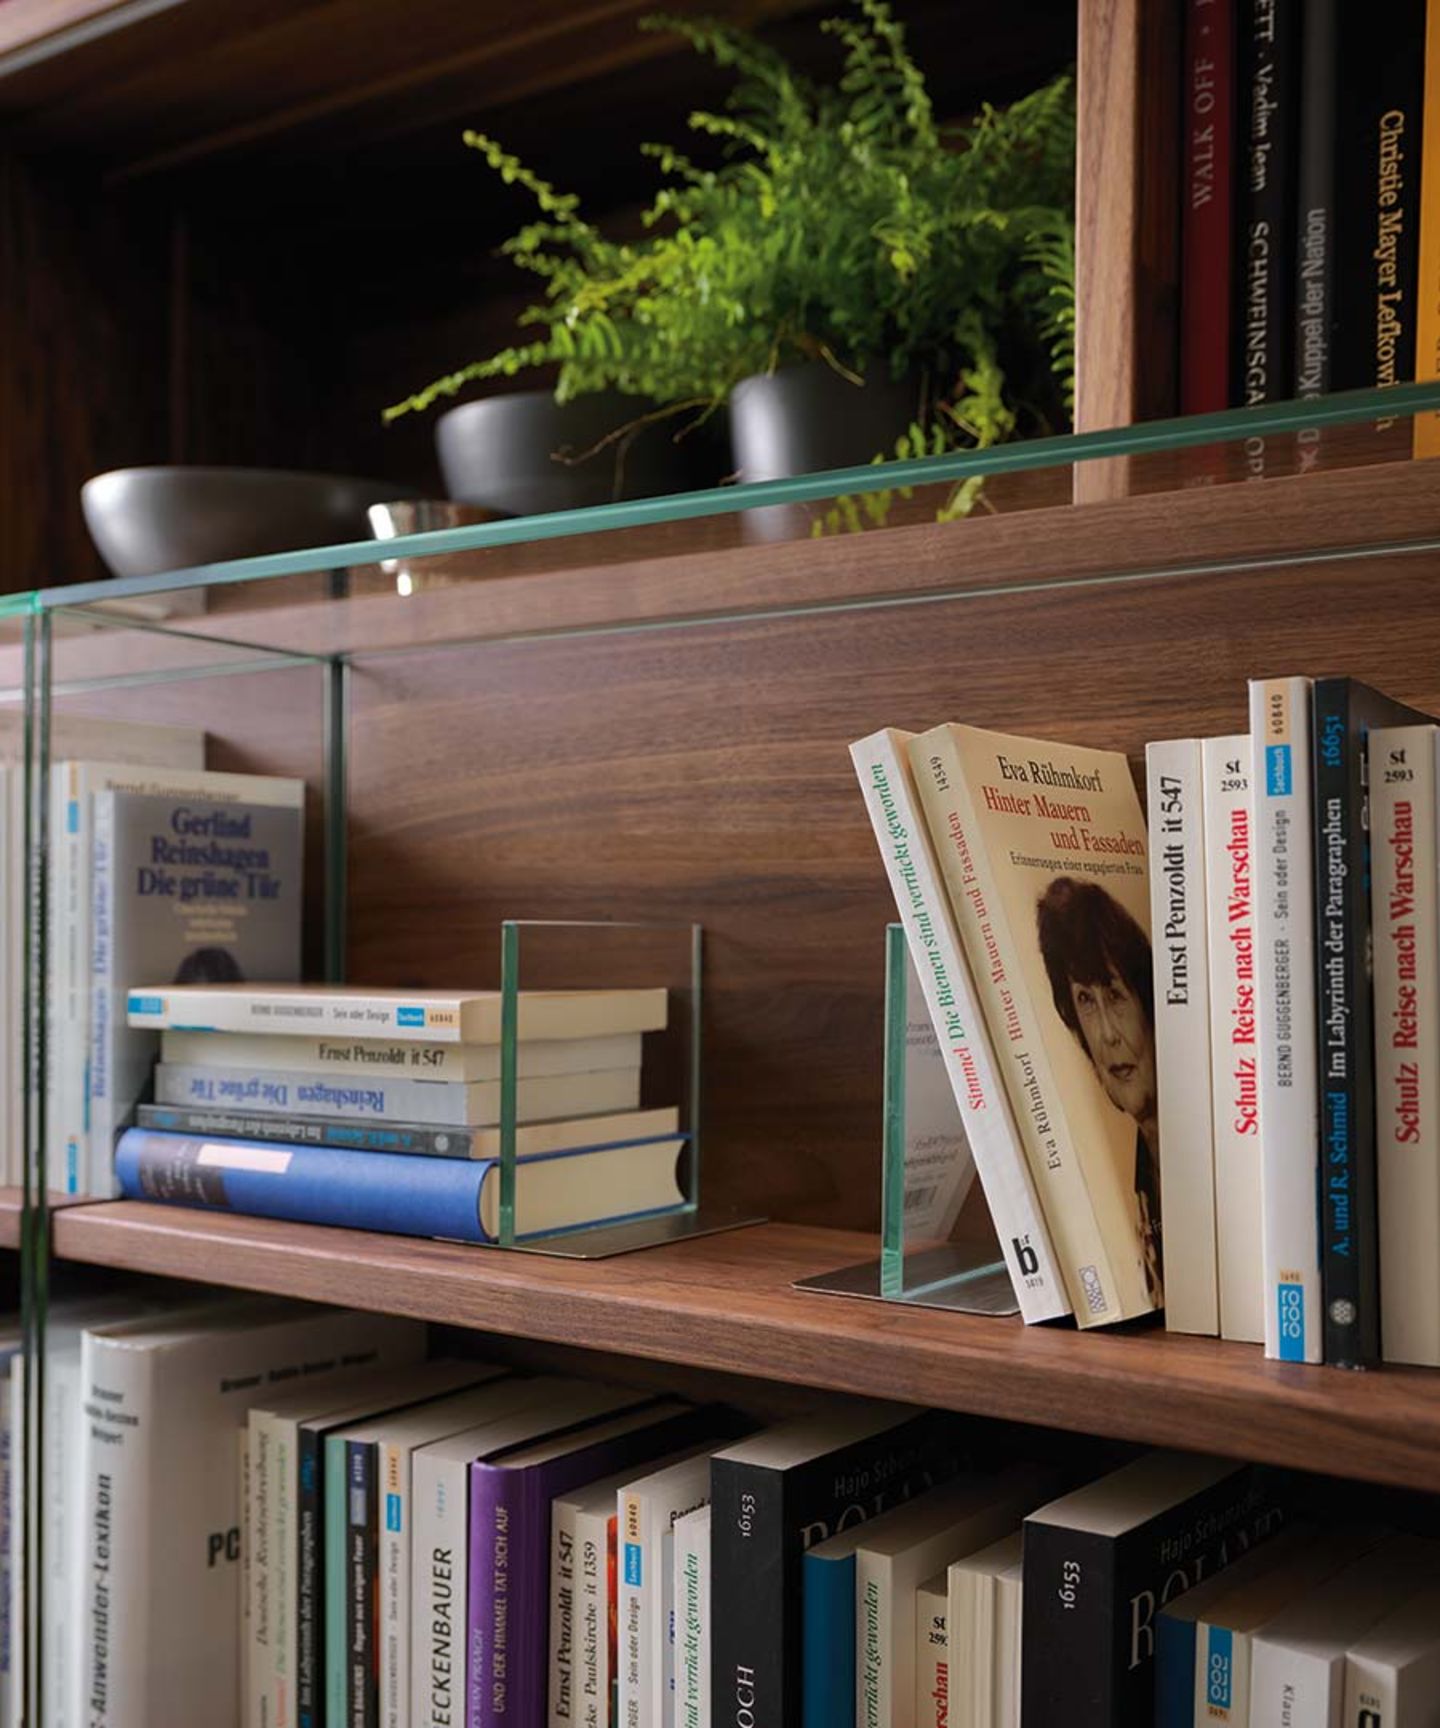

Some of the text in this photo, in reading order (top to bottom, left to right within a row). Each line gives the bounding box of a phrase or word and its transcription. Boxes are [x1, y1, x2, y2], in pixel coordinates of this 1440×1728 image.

[1193, 59, 1215, 209] WALK OFF
[1378, 110, 1405, 206] Christie
[1302, 209, 1326, 278] Nation
[1374, 207, 1403, 287] Mayer
[1301, 281, 1324, 315] der
[1299, 317, 1328, 394] Kuppel
[1271, 694, 1283, 735] 60840
[1322, 715, 1345, 768] 16651
[1389, 749, 1406, 765] st
[929, 756, 950, 792] 14549
[997, 755, 1104, 793] Eva Rühmkorf
[1221, 778, 1249, 793] 2593
[1226, 758, 1241, 774] st
[1384, 769, 1415, 784] 2593
[982, 785, 1092, 823] Hinter Mauern
[152, 836, 271, 872] Reinshagen
[1050, 825, 1145, 857] und Fassaden
[137, 867, 175, 896] Die
[1160, 776, 1189, 1006] Ernst Penzoldt it 547
[871, 763, 987, 1111] Simmel Die Bienen sind verrückt geworden
[1272, 810, 1293, 1087] BERND GUGGENBERGER Sein oder Design
[949, 811, 1062, 1170] Eva Rühmkorf Hinter Mauern und Fassaden
[1225, 808, 1259, 1136] Schulz Reise nach Warschau
[1388, 801, 1421, 1144] Schulz Reise nach Warschau
[1322, 797, 1350, 1256] A. und R. Schmid Im Labyrinth der Paragraphen
[319, 1043, 350, 1060] Ernst
[353, 1045, 406, 1065] Penzoldt
[422, 1050, 446, 1067] 547
[261, 1082, 289, 1106] Die
[297, 1081, 385, 1113] Reinshagen
[628, 1503, 638, 1537] 60840
[738, 1493, 756, 1537] 16153
[207, 1525, 240, 1569] PC
[583, 1541, 597, 1577] 1359
[583, 1583, 597, 1596] it
[682, 1552, 701, 1634] geworden
[1058, 1560, 1081, 1610] 16153
[492, 1504, 510, 1713] UND DER HIMMEL TAT SICH AUF
[556, 1530, 575, 1719] Ernst Penzoldt it 547
[627, 1596, 640, 1633] Design
[864, 1580, 882, 1664] geworden
[933, 1615, 946, 1631] st
[583, 1603, 598, 1696] Paulskirche
[627, 1634, 639, 1659] oder
[683, 1633, 699, 1701] verrückt
[627, 1660, 639, 1685] Sein
